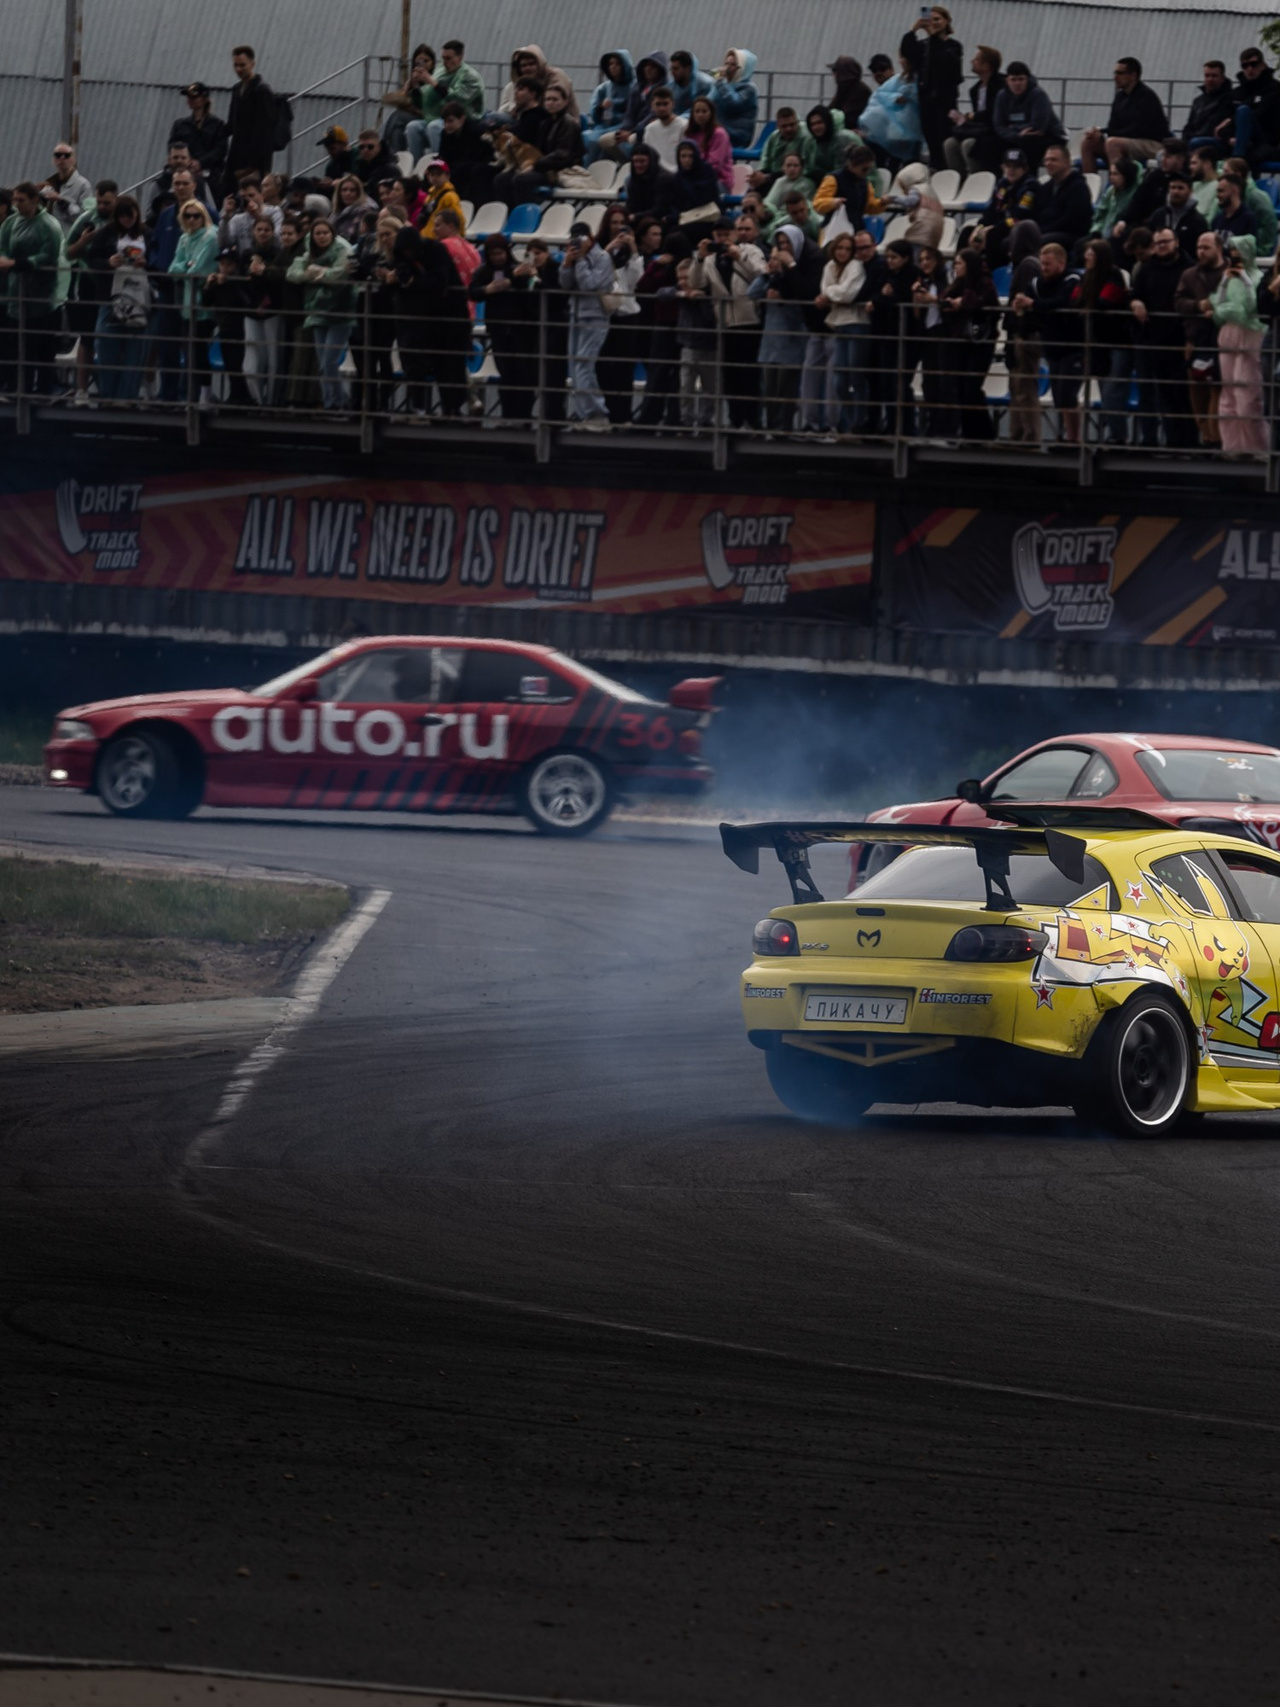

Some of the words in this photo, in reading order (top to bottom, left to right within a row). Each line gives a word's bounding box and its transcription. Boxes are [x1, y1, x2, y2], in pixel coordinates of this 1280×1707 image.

[80, 484, 143, 513] DRIFT
[90, 531, 138, 550] TRACK
[726, 516, 793, 547] DRIFT
[235, 495, 294, 573] ALL
[307, 499, 363, 577] WE
[367, 503, 455, 582] NEED
[460, 506, 499, 586] IS
[503, 509, 606, 589] DRIFT
[1043, 534, 1113, 565] DRIFT
[95, 550, 140, 569] MODE
[736, 565, 789, 584] TRACK
[743, 584, 790, 604] MODE
[1053, 585, 1107, 603] TRACK
[1059, 603, 1110, 622] MODE
[210, 702, 509, 760] auto.ru
[616, 713, 675, 751] 36
[919, 987, 992, 1005] KINFOREST
[816, 1002, 895, 1021] ПИКАЧУ
